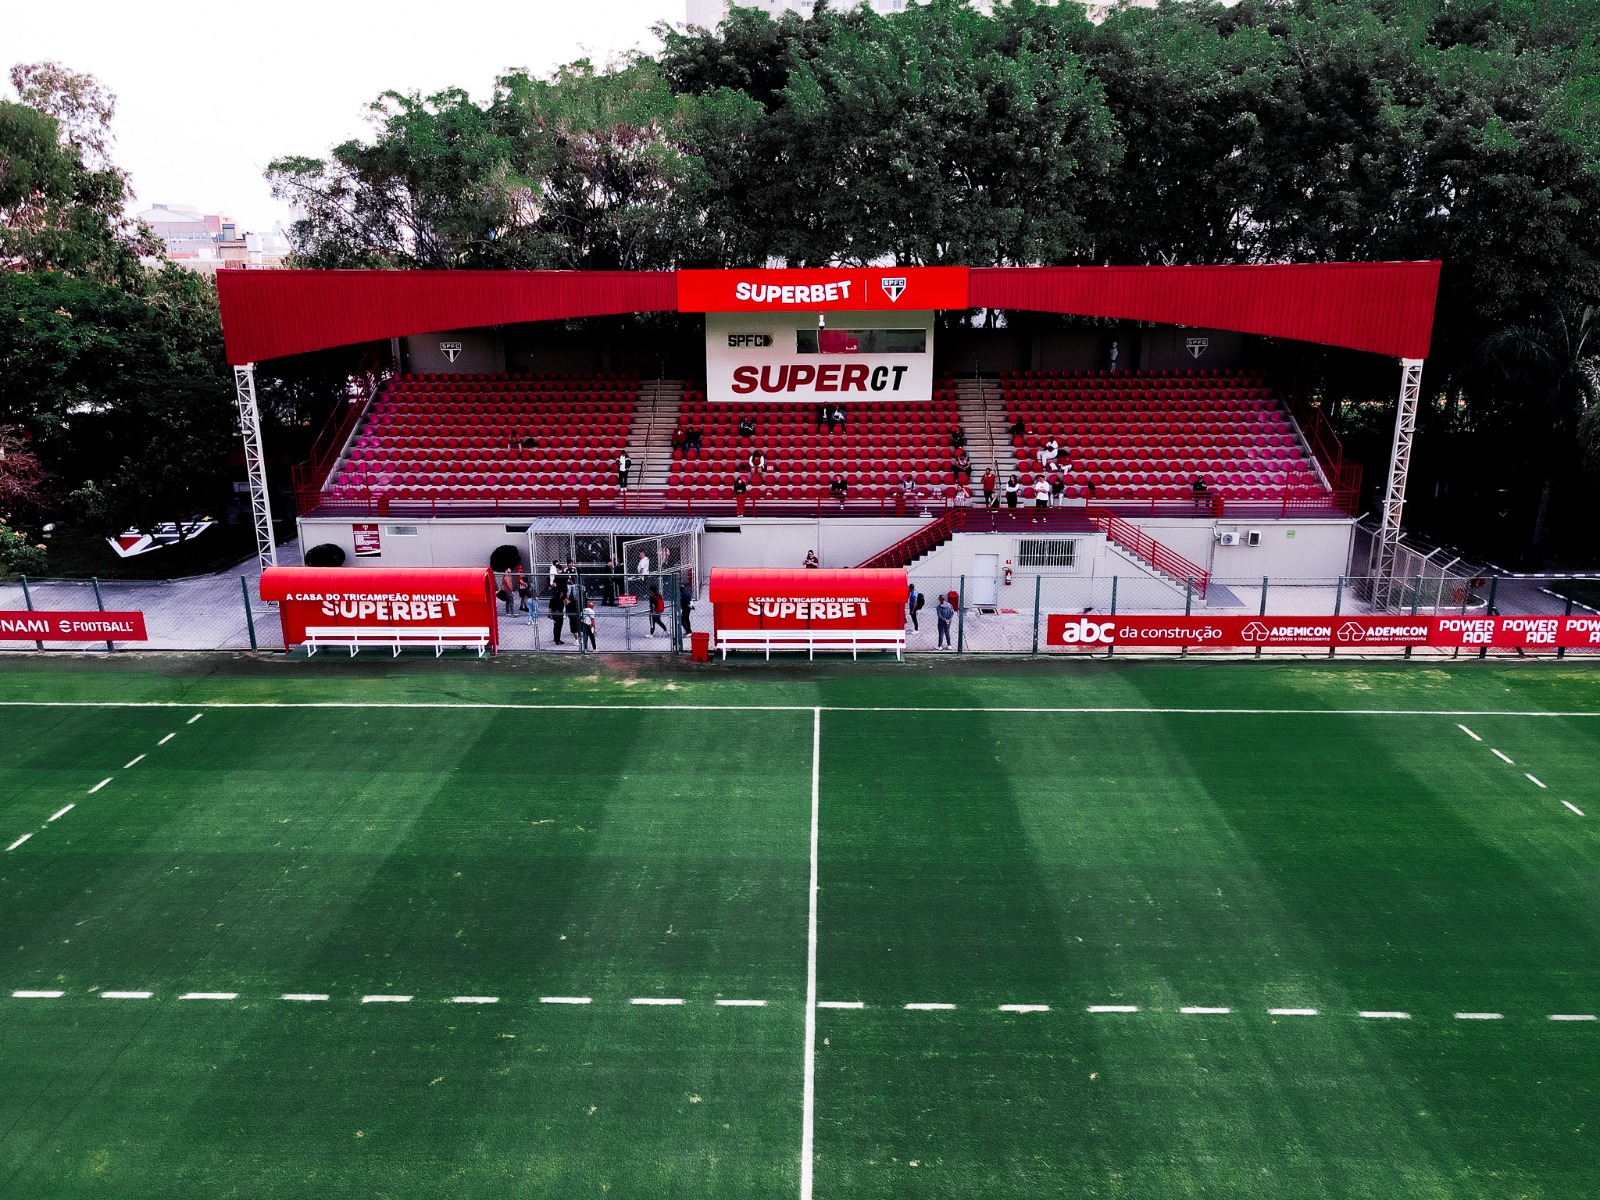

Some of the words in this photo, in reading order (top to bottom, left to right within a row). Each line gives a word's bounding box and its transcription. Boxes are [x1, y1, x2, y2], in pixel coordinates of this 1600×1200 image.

[883, 279, 905, 287] SPFC
[735, 280, 852, 304] SUPERBET
[728, 334, 764, 348] SPFC
[286, 593, 294, 601] A
[295, 593, 323, 601] CASA
[326, 593, 341, 601] DO
[343, 592, 406, 602] TRICAMPEÃO
[407, 593, 460, 602] MUNDIAL
[321, 600, 457, 621] SUPERBET
[747, 602, 868, 620] SUPERBET
[0, 620, 50, 633] NAMI
[1062, 618, 1116, 643] abc
[1119, 626, 1138, 639] da
[1140, 626, 1223, 642] construção
[1270, 626, 1332, 637] ADEMICON
[1366, 626, 1428, 637] ADEMICON
[1438, 619, 1495, 632] POWER
[1502, 619, 1559, 632] POWER
[1462, 631, 1494, 644] ADE
[1525, 631, 1557, 644] ADE
